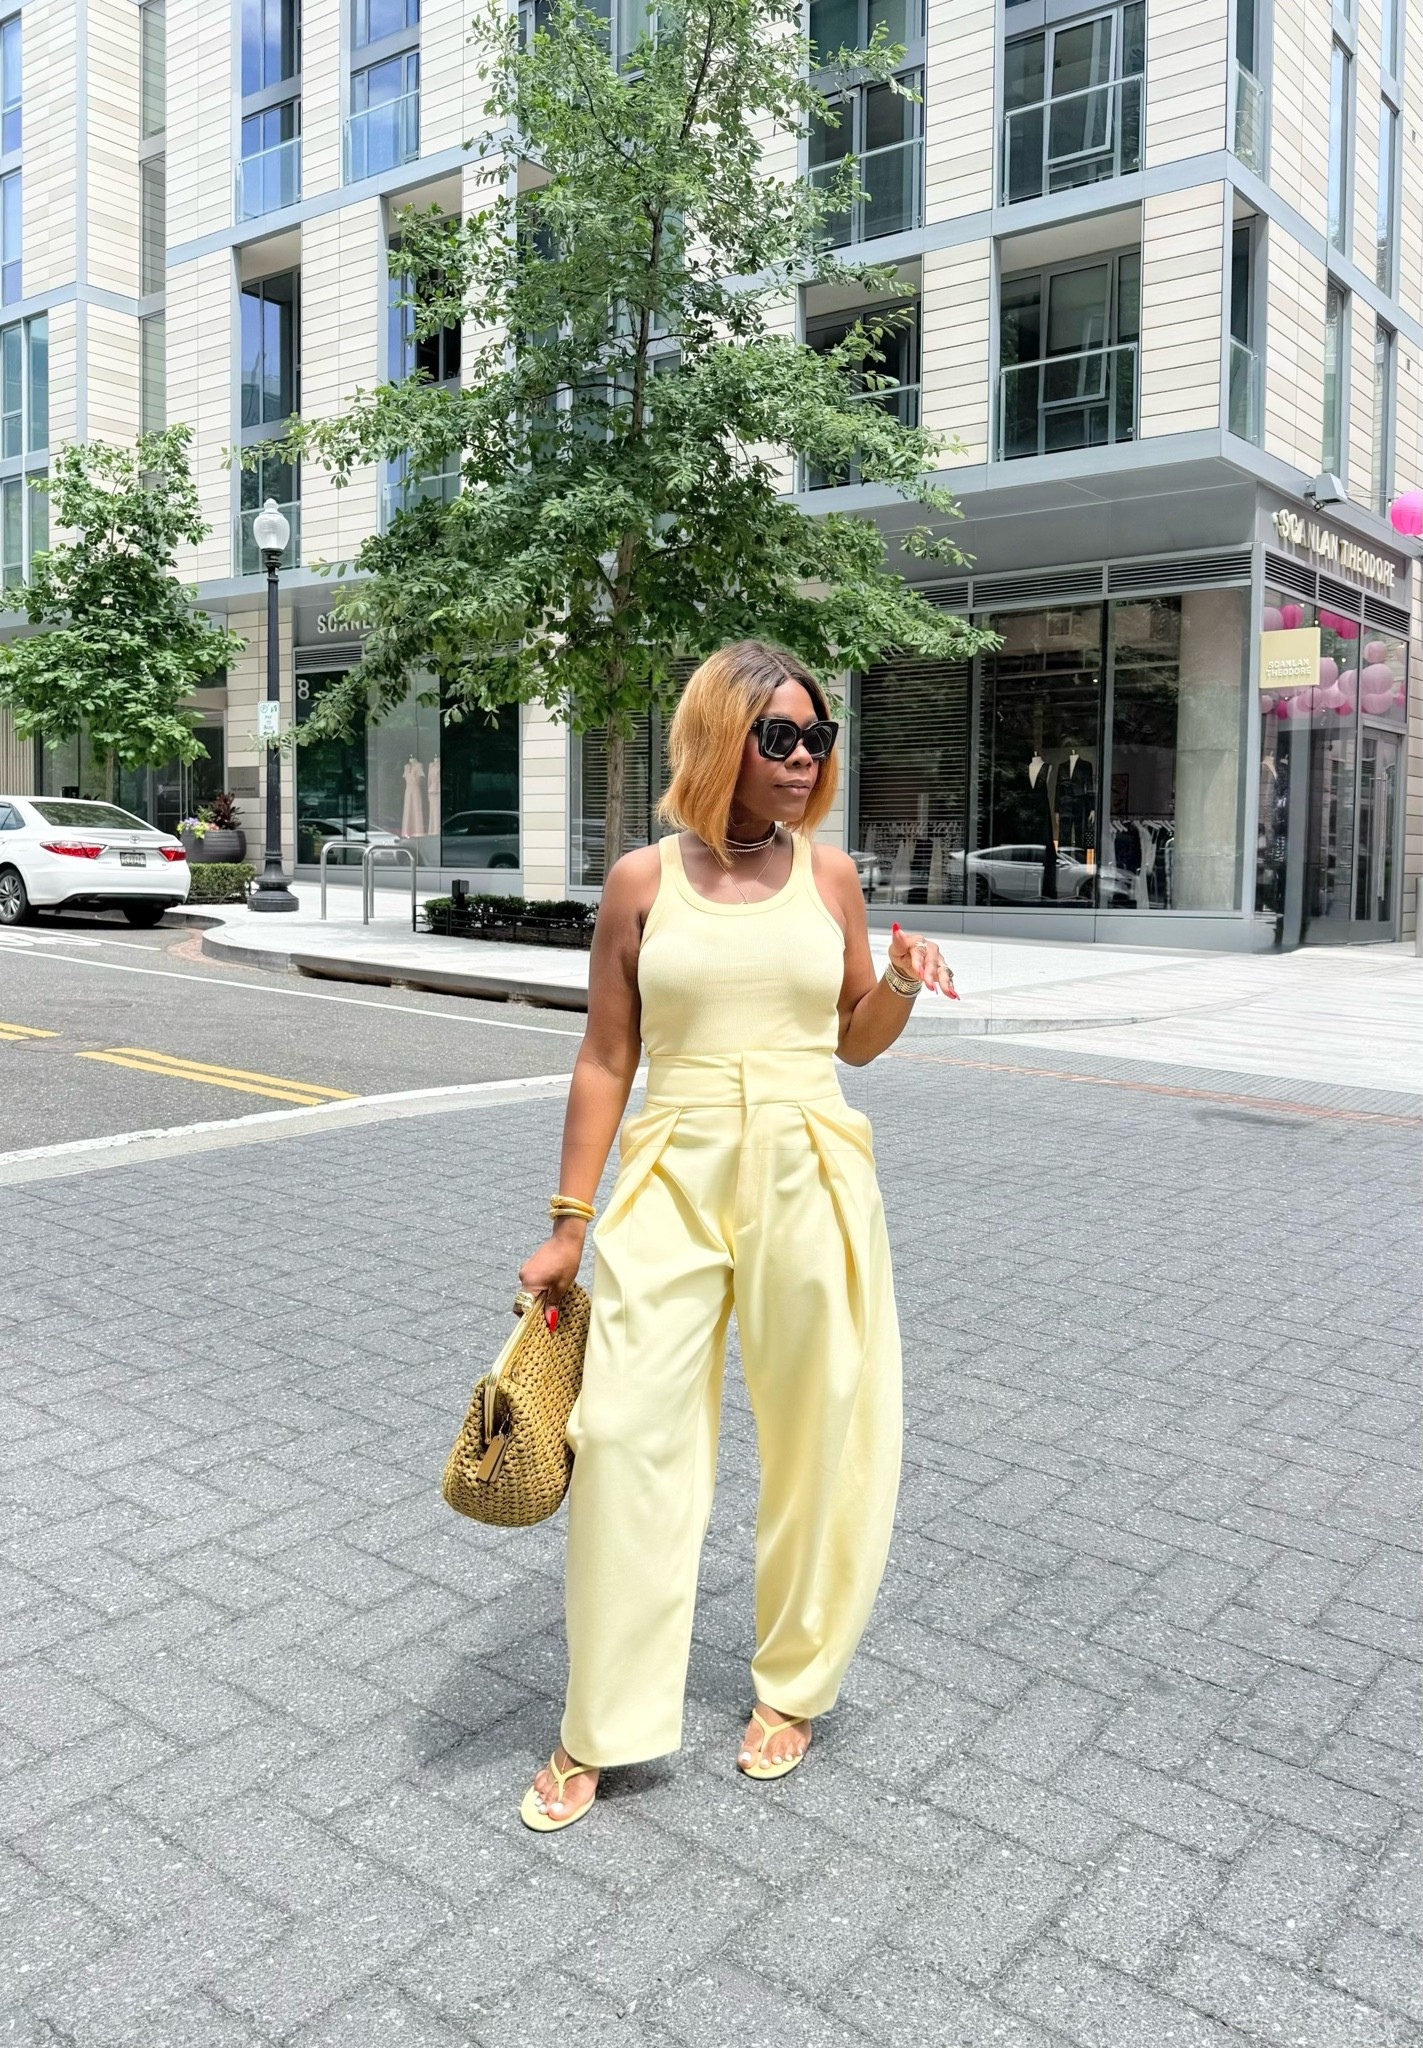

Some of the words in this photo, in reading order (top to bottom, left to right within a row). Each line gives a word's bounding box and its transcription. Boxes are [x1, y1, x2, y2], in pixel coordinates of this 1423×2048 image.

[1278, 509, 1339, 560] SCANLAN
[1339, 539, 1395, 588] THEODORE
[1268, 658, 1310, 669] SCANLAN
[1265, 666, 1312, 677] THEODORE
